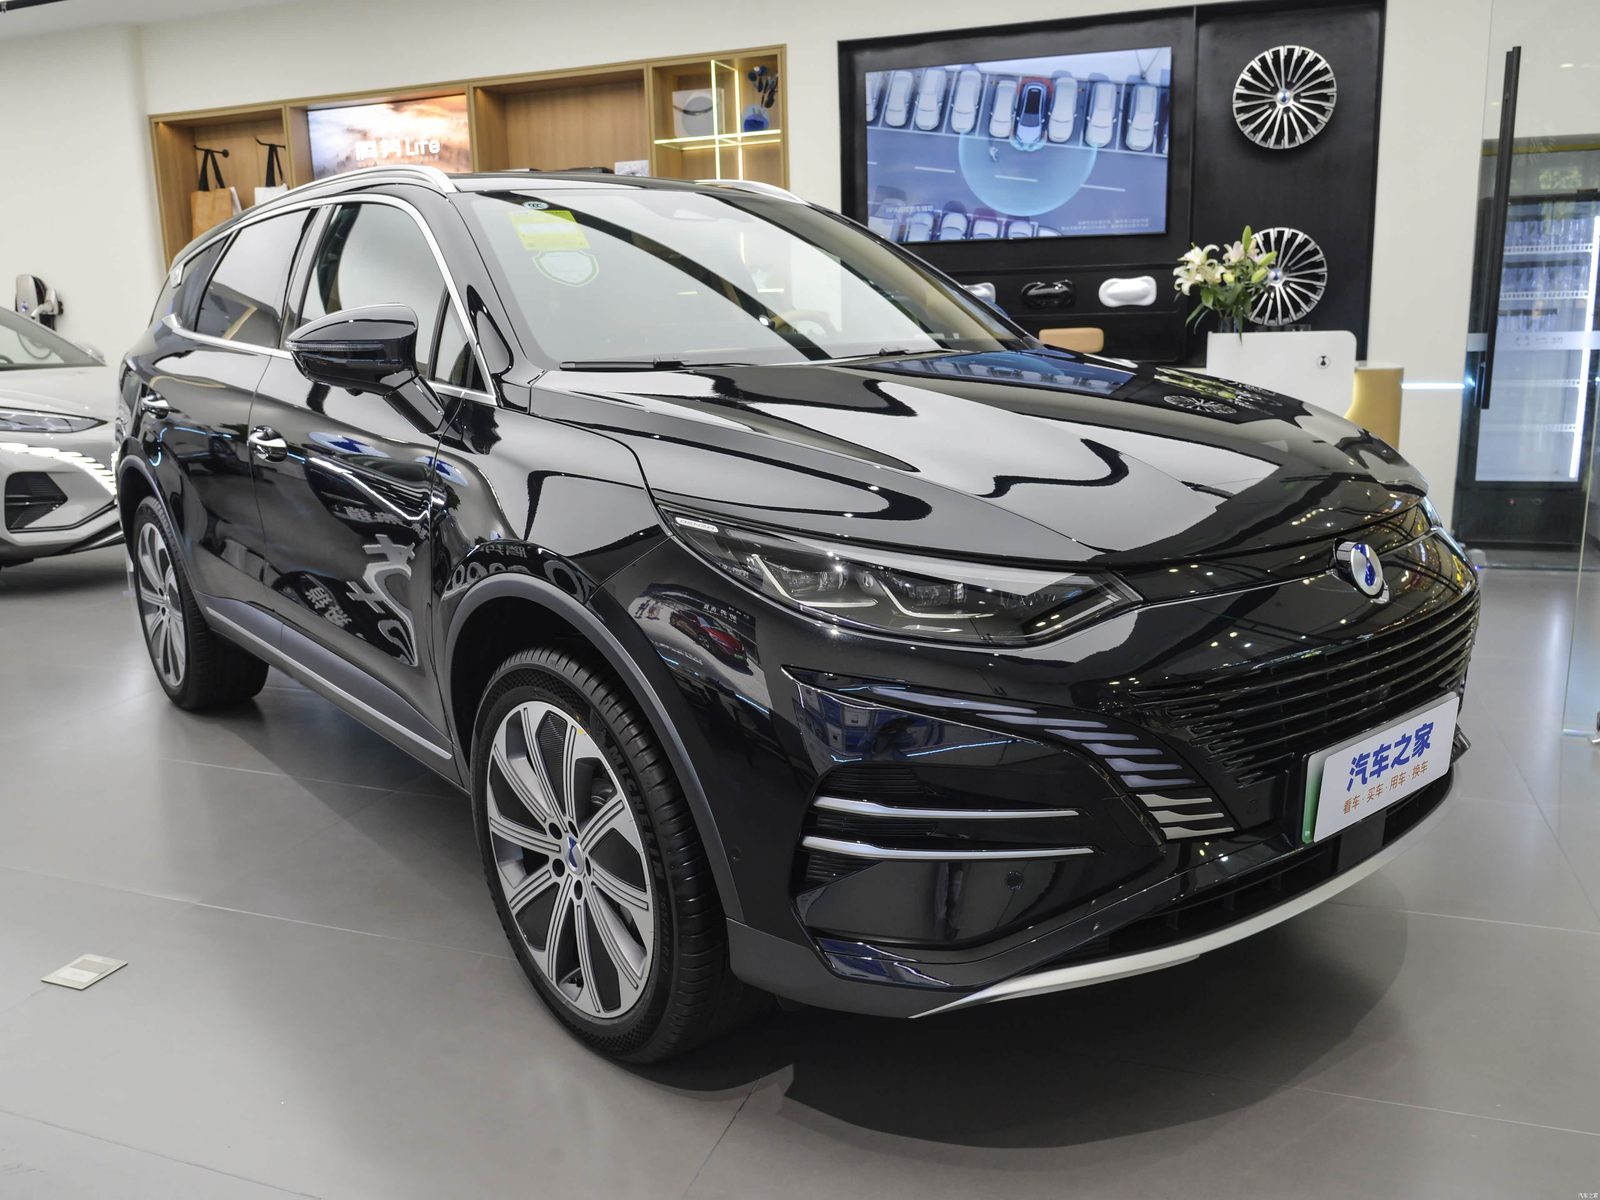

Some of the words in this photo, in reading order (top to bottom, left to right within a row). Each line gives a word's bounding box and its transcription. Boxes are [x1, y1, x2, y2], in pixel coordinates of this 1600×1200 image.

[1346, 722, 1434, 792] 汽车之家
[608, 745, 666, 880] MICHELIN
